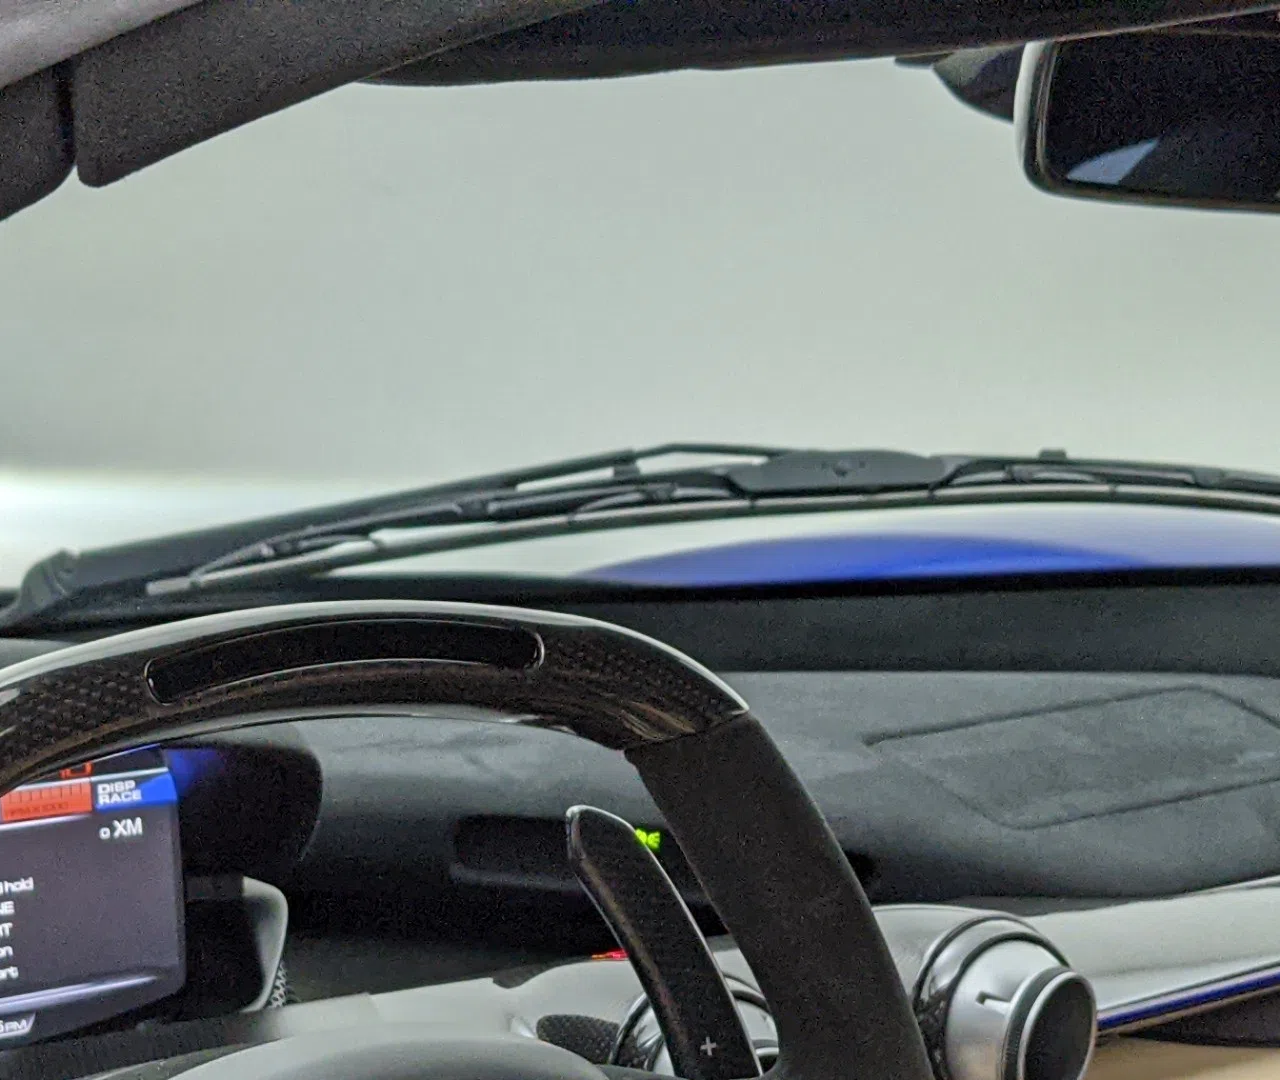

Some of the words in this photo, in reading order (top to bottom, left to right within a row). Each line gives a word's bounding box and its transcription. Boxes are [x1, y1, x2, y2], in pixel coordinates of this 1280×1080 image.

[97, 780, 136, 794] DISP
[98, 789, 142, 805] RACE
[113, 817, 143, 838] XM
